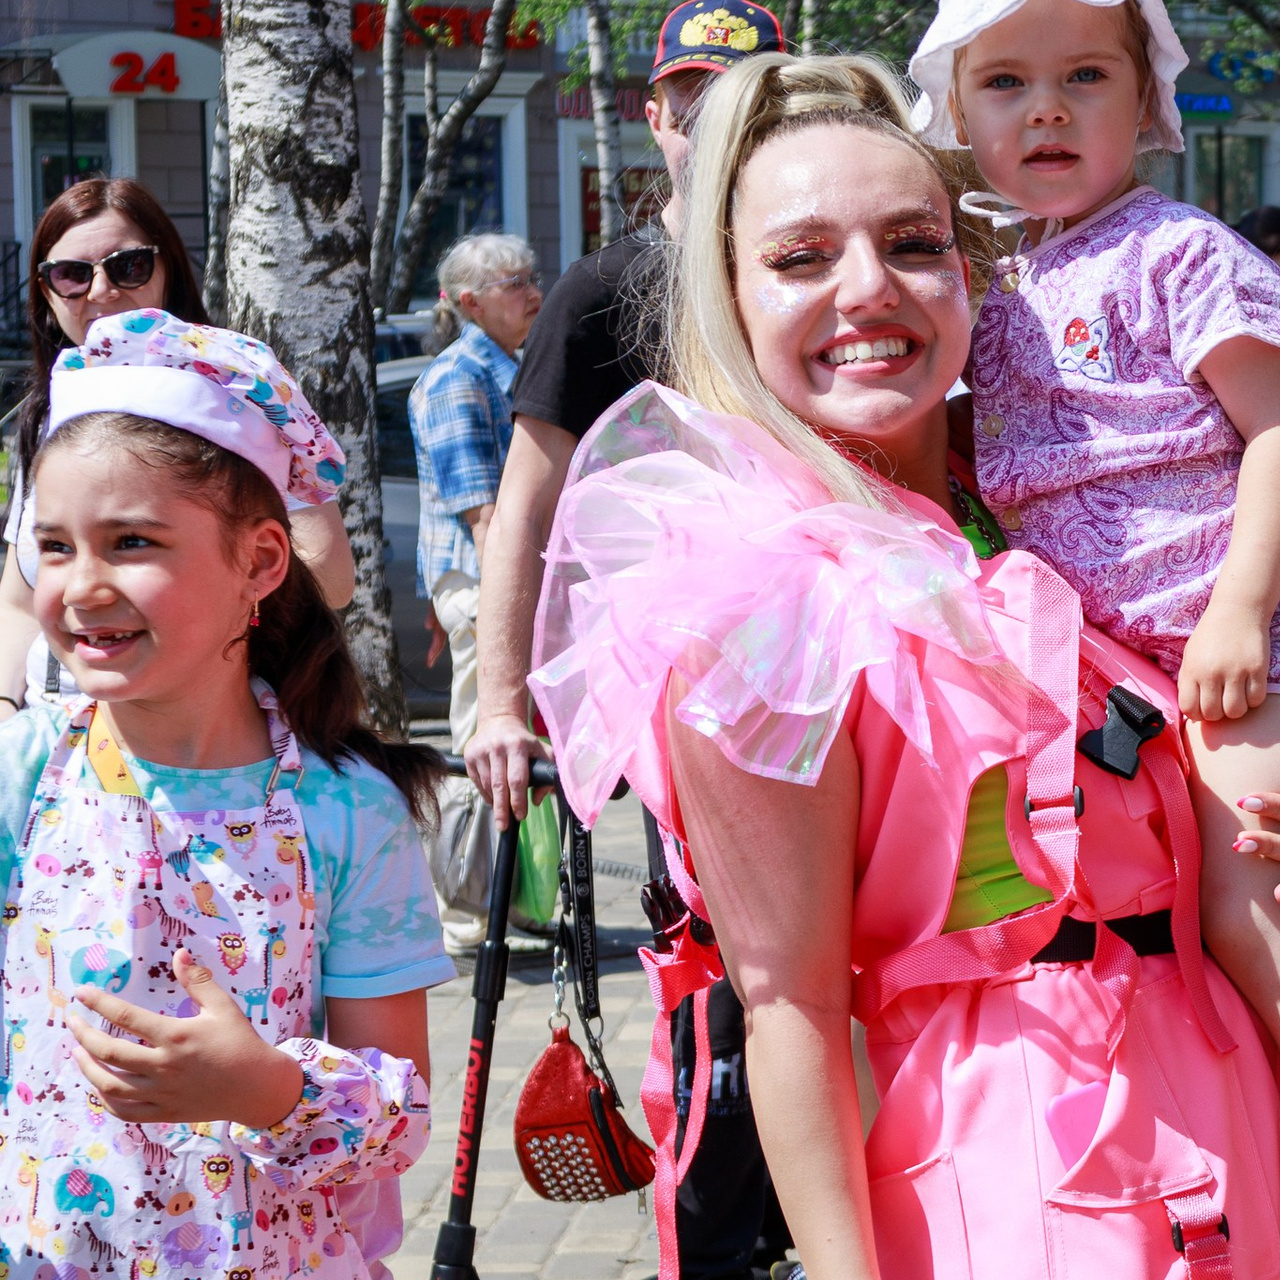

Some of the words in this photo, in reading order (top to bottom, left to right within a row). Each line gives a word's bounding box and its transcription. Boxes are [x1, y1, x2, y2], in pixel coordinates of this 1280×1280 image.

[110, 51, 180, 93] 24
[575, 840, 588, 878] BORN
[579, 912, 593, 967] CHAMPS
